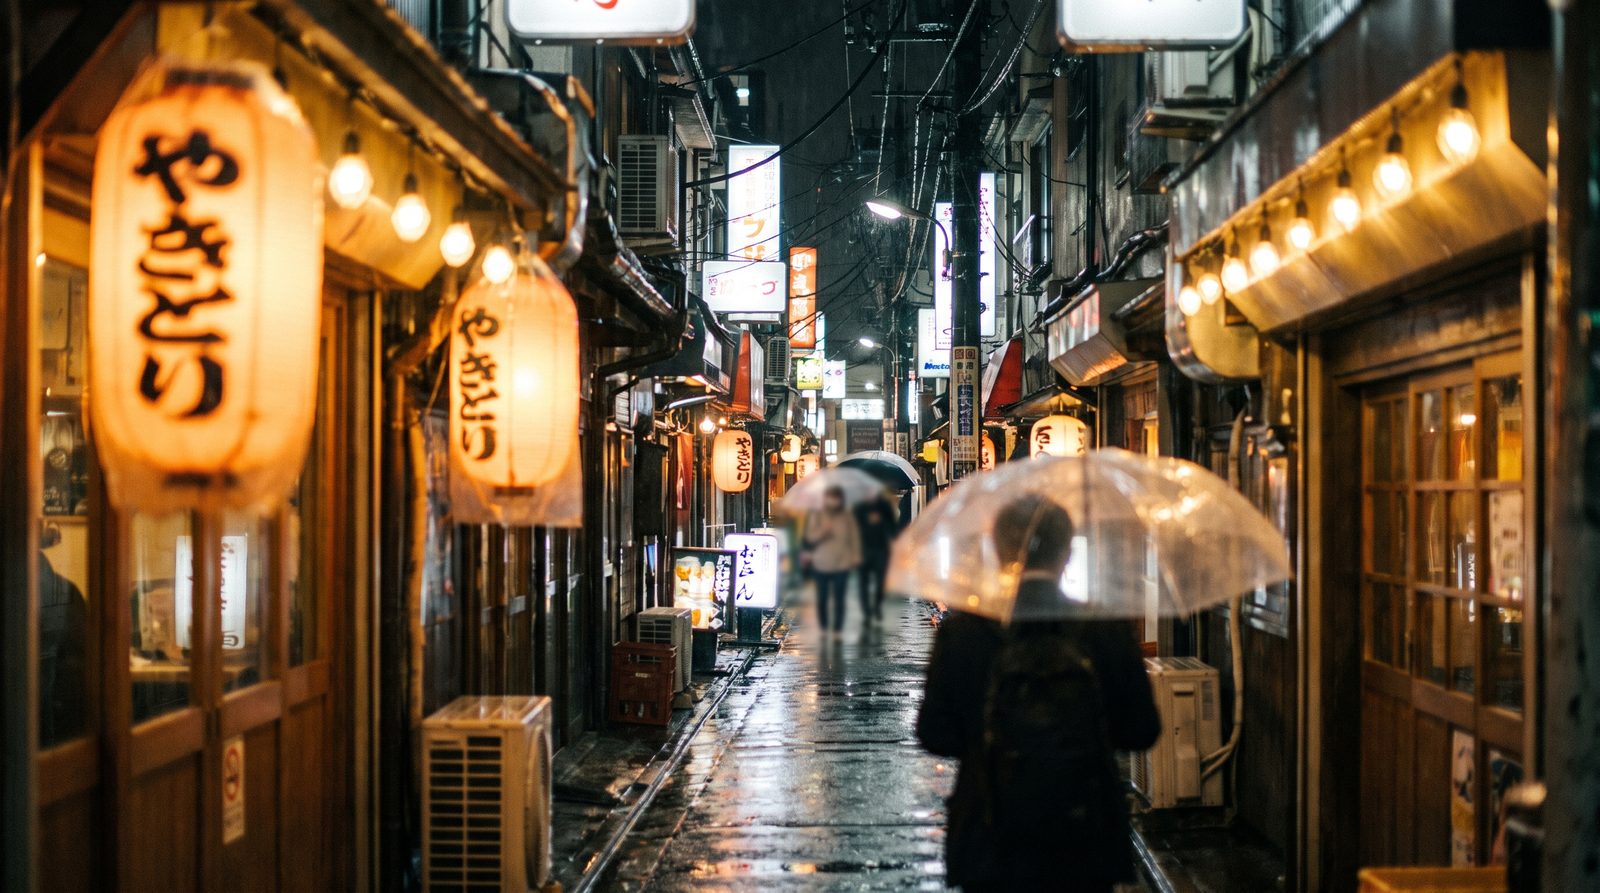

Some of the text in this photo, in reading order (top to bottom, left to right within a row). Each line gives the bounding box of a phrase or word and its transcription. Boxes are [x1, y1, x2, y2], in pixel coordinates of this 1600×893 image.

[133, 127, 241, 418] やきとり
[458, 308, 499, 461] やきとり
[735, 437, 752, 484] やきとり
